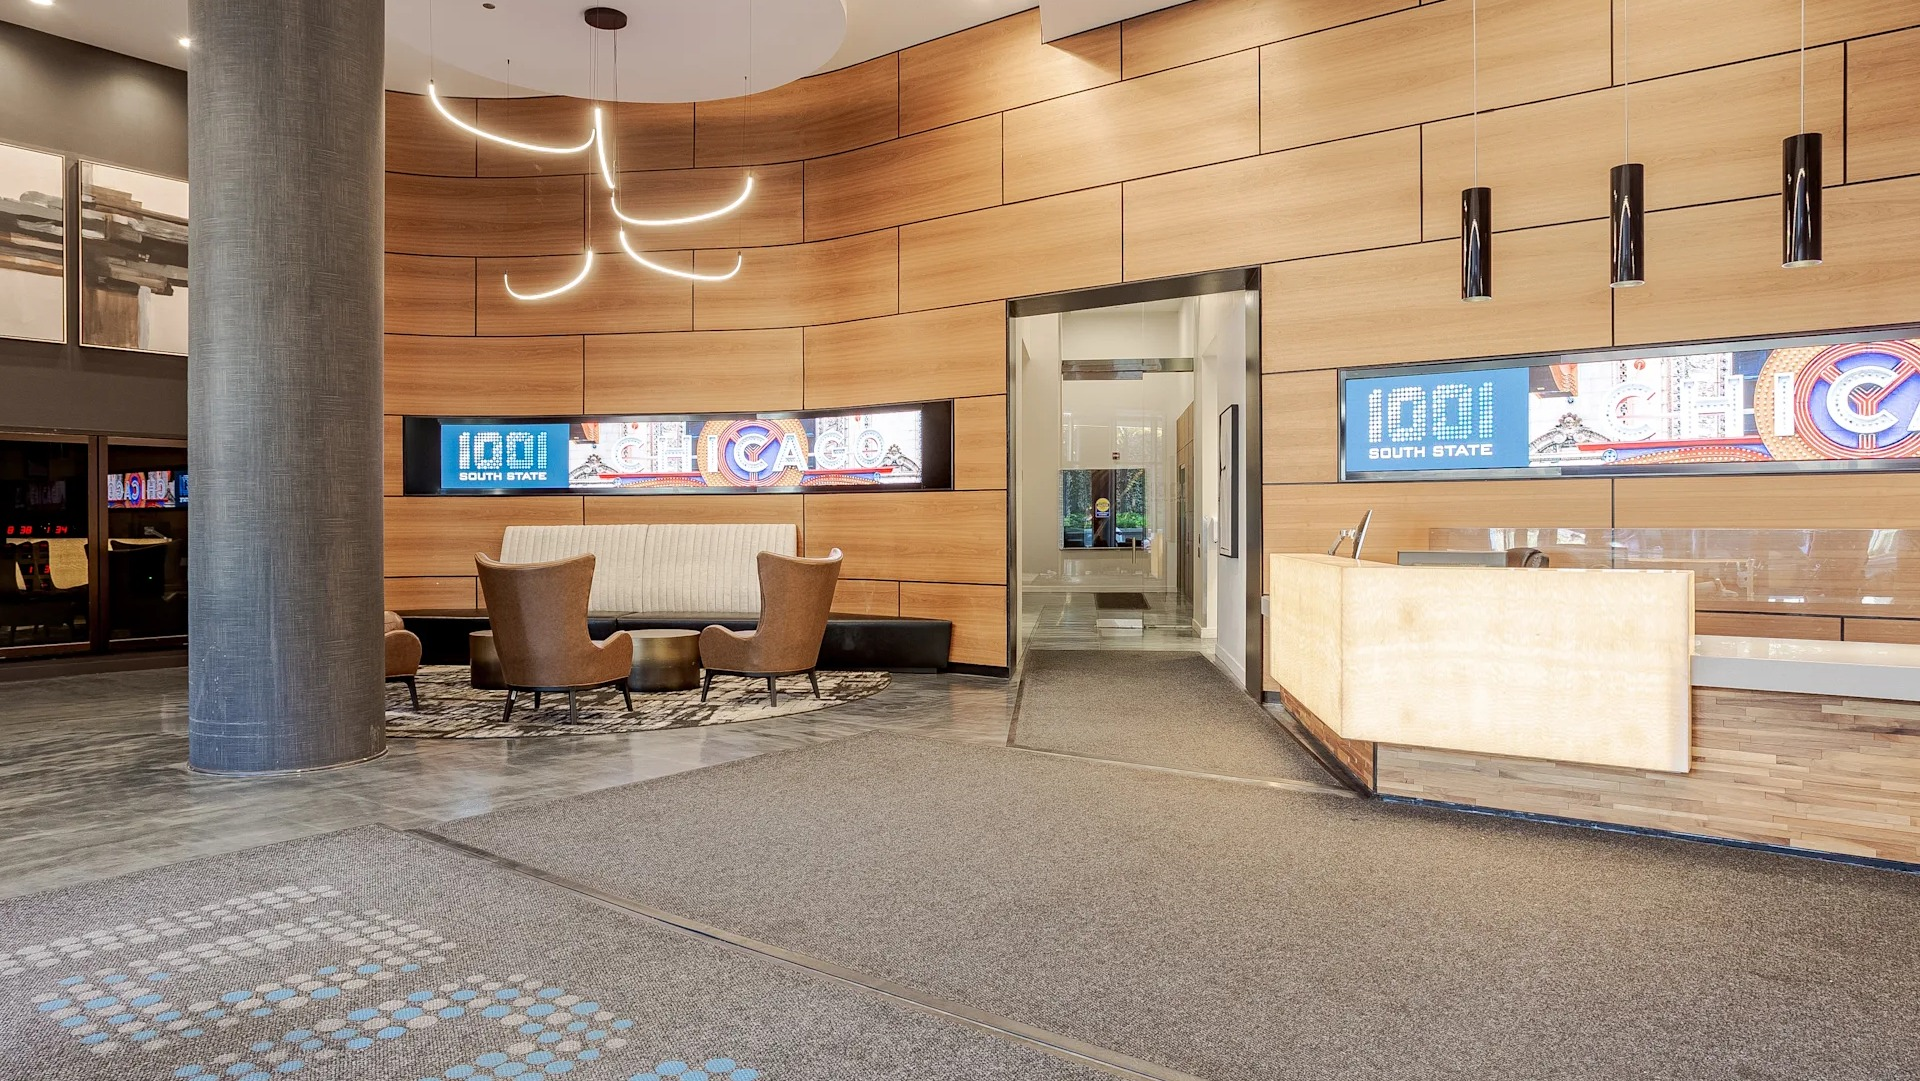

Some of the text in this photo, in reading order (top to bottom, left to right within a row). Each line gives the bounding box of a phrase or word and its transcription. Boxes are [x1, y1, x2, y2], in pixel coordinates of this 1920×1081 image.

[1367, 381, 1494, 443] 1001
[1603, 364, 1920, 441] CHIC
[458, 431, 547, 471] 1001
[612, 429, 887, 473] CHICAGO
[1368, 443, 1494, 460] SOUTH STATE
[458, 471, 547, 482] SOUTH STATE
